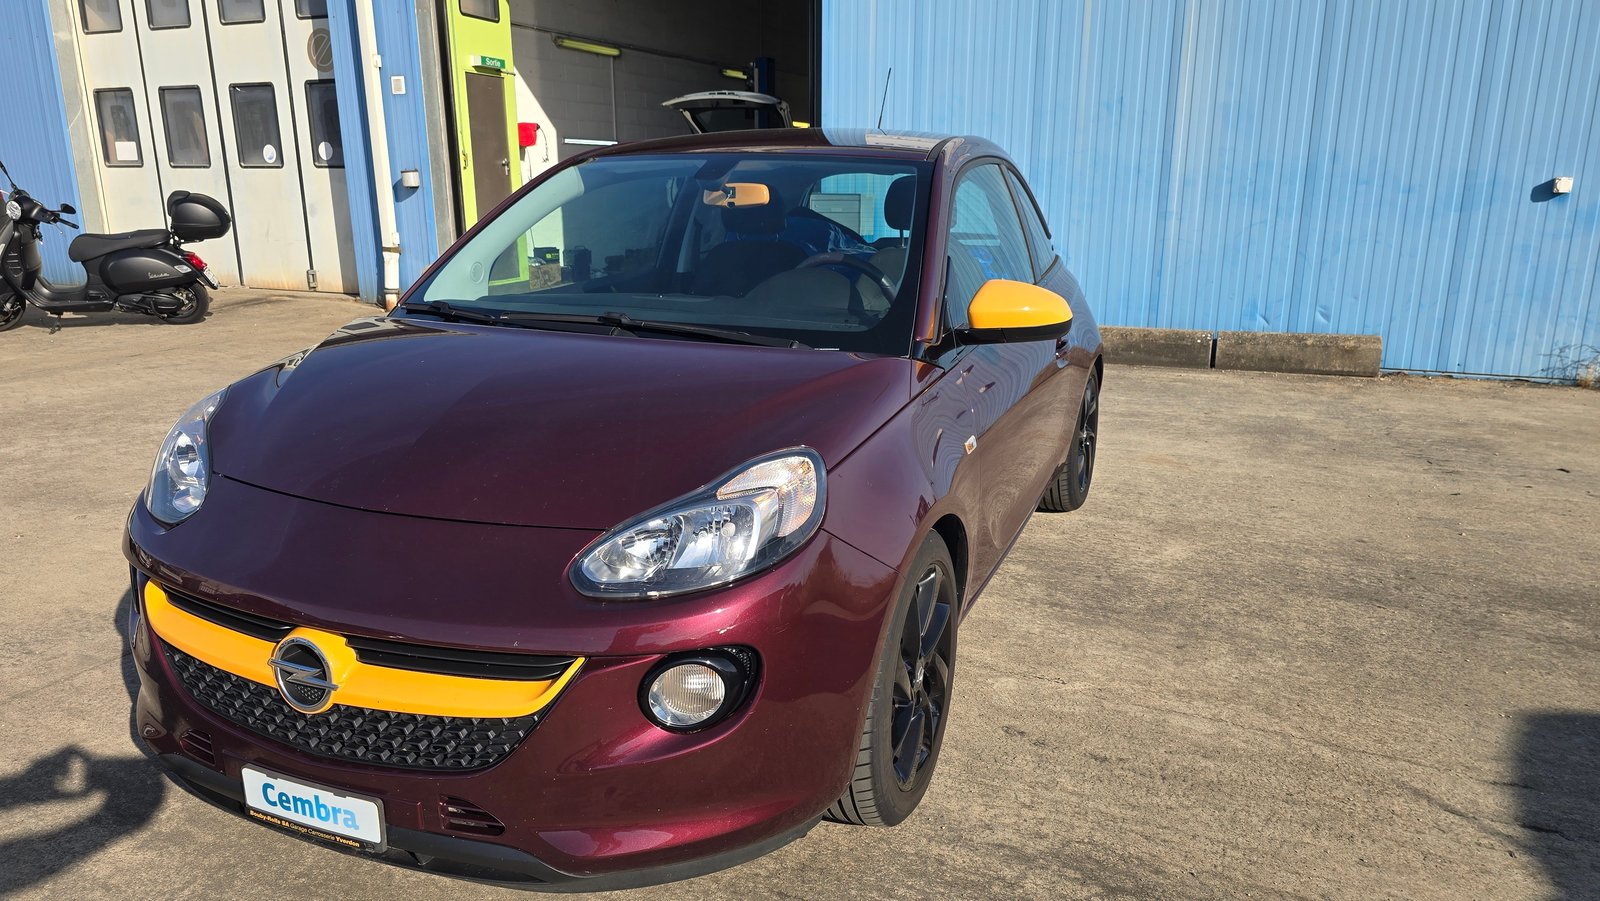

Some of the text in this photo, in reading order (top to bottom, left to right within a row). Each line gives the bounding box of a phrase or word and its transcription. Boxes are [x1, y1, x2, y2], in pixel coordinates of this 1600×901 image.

[485, 57, 501, 67] Sortie
[262, 783, 360, 830] Cembra
[290, 822, 308, 833] Garage
[308, 828, 335, 841] Carrosserie
[335, 836, 360, 848] Yverdon
